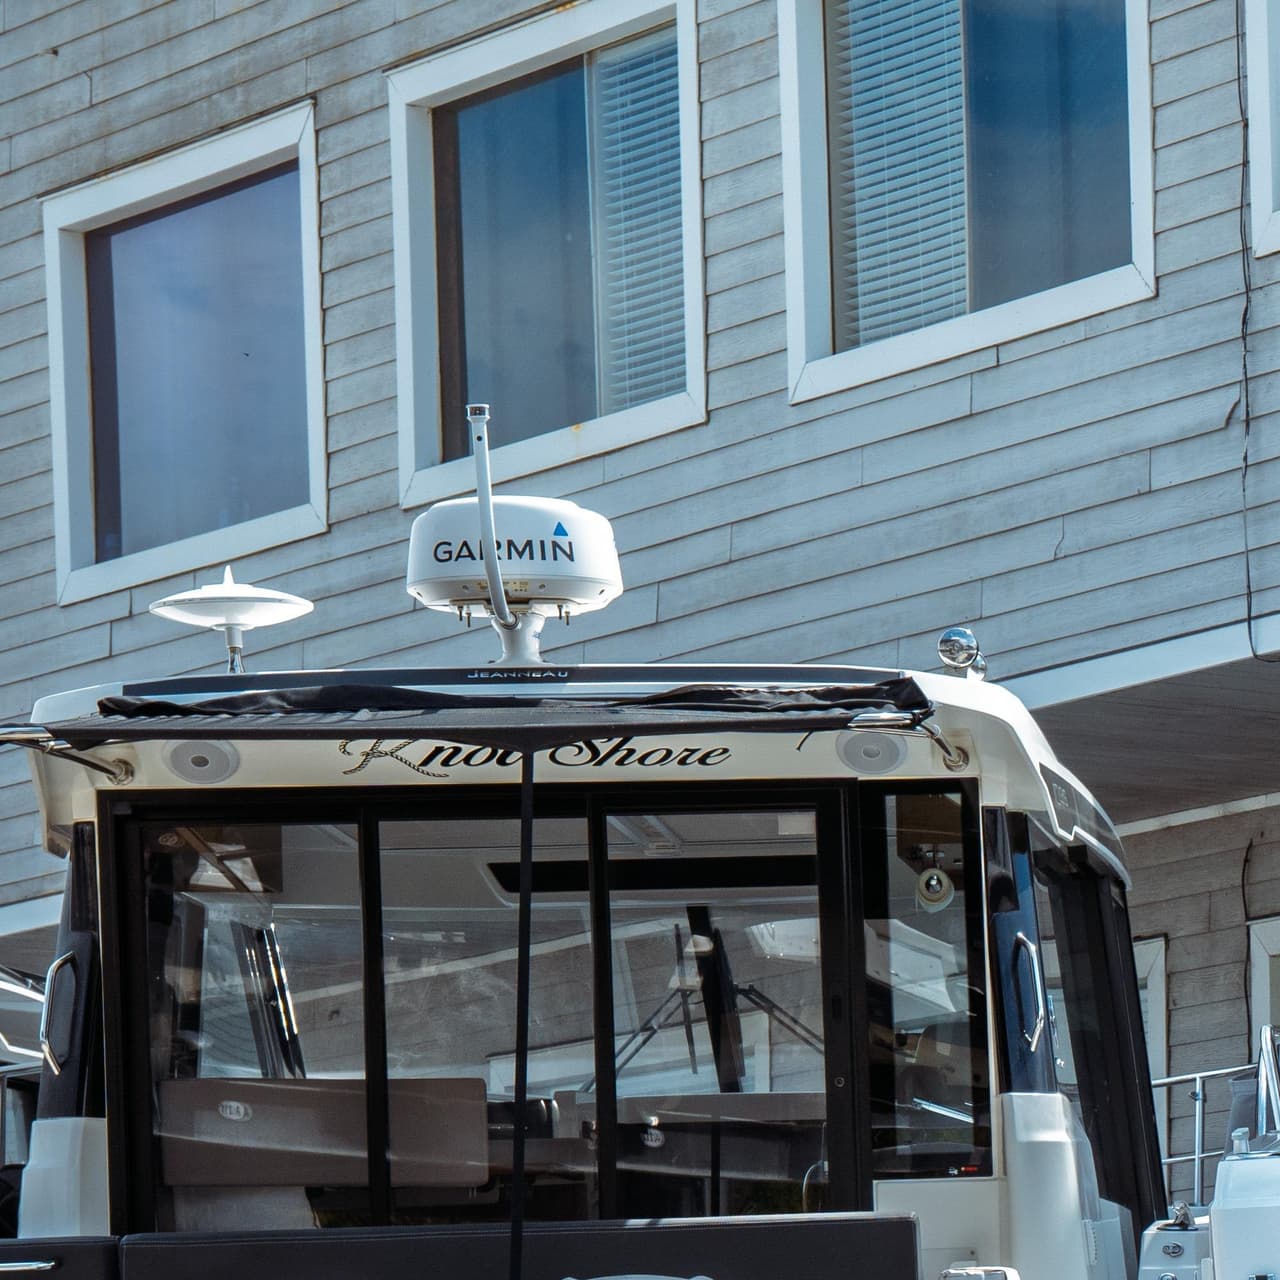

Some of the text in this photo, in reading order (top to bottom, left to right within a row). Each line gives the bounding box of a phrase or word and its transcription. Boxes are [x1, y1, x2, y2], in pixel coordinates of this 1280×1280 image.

[433, 539, 575, 562] GARMIN
[467, 670, 568, 679] JEANNEAU
[548, 736, 732, 767] Shore
